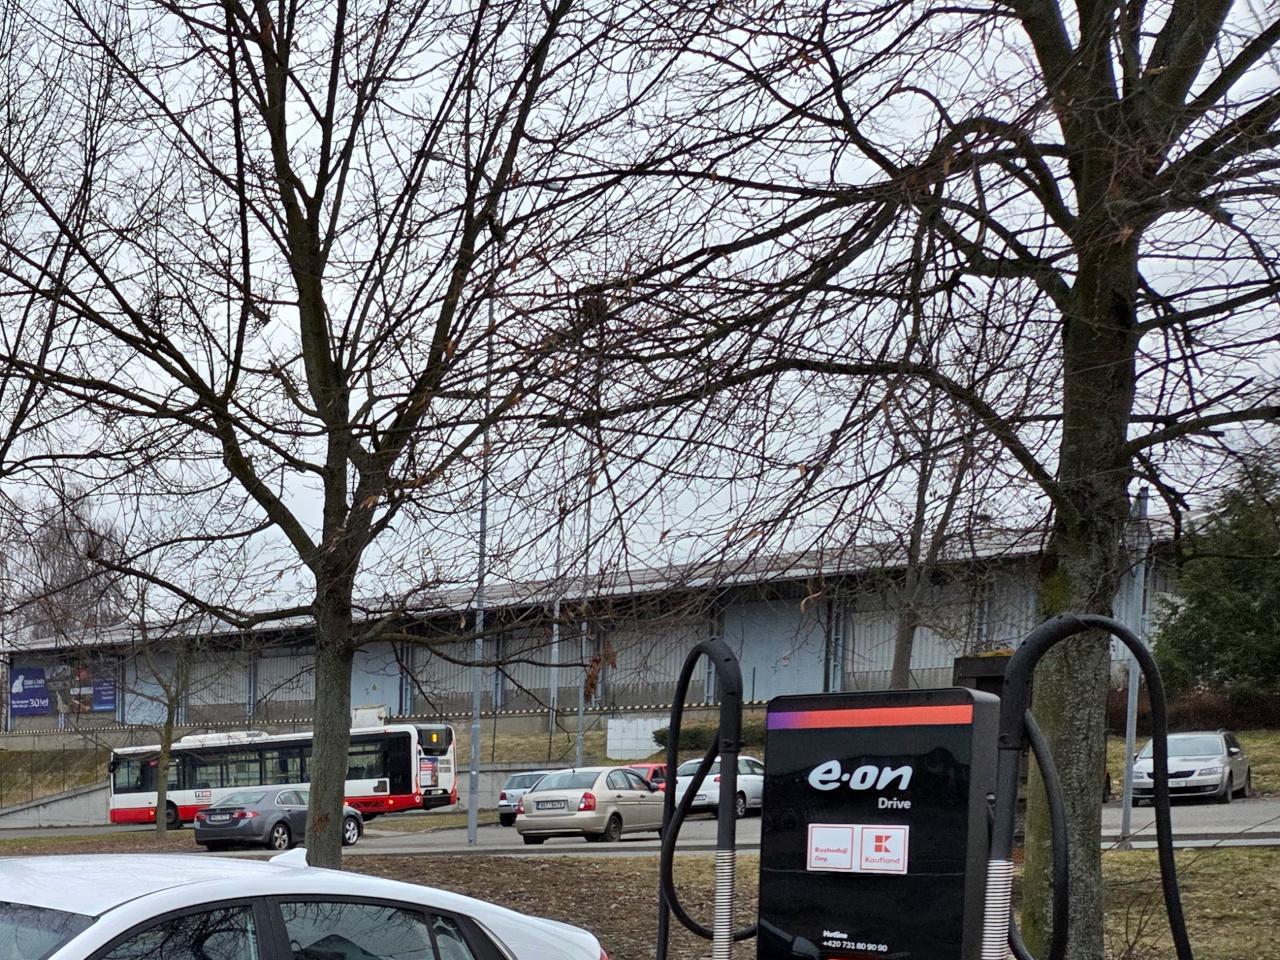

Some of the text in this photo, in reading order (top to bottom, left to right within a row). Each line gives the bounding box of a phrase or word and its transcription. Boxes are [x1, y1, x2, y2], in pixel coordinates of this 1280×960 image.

[878, 797, 912, 809] Drive
[865, 856, 900, 864] Kaufland
[823, 930, 848, 939] Hotline
[842, 941, 855, 949] 731
[877, 944, 888, 952] 90
